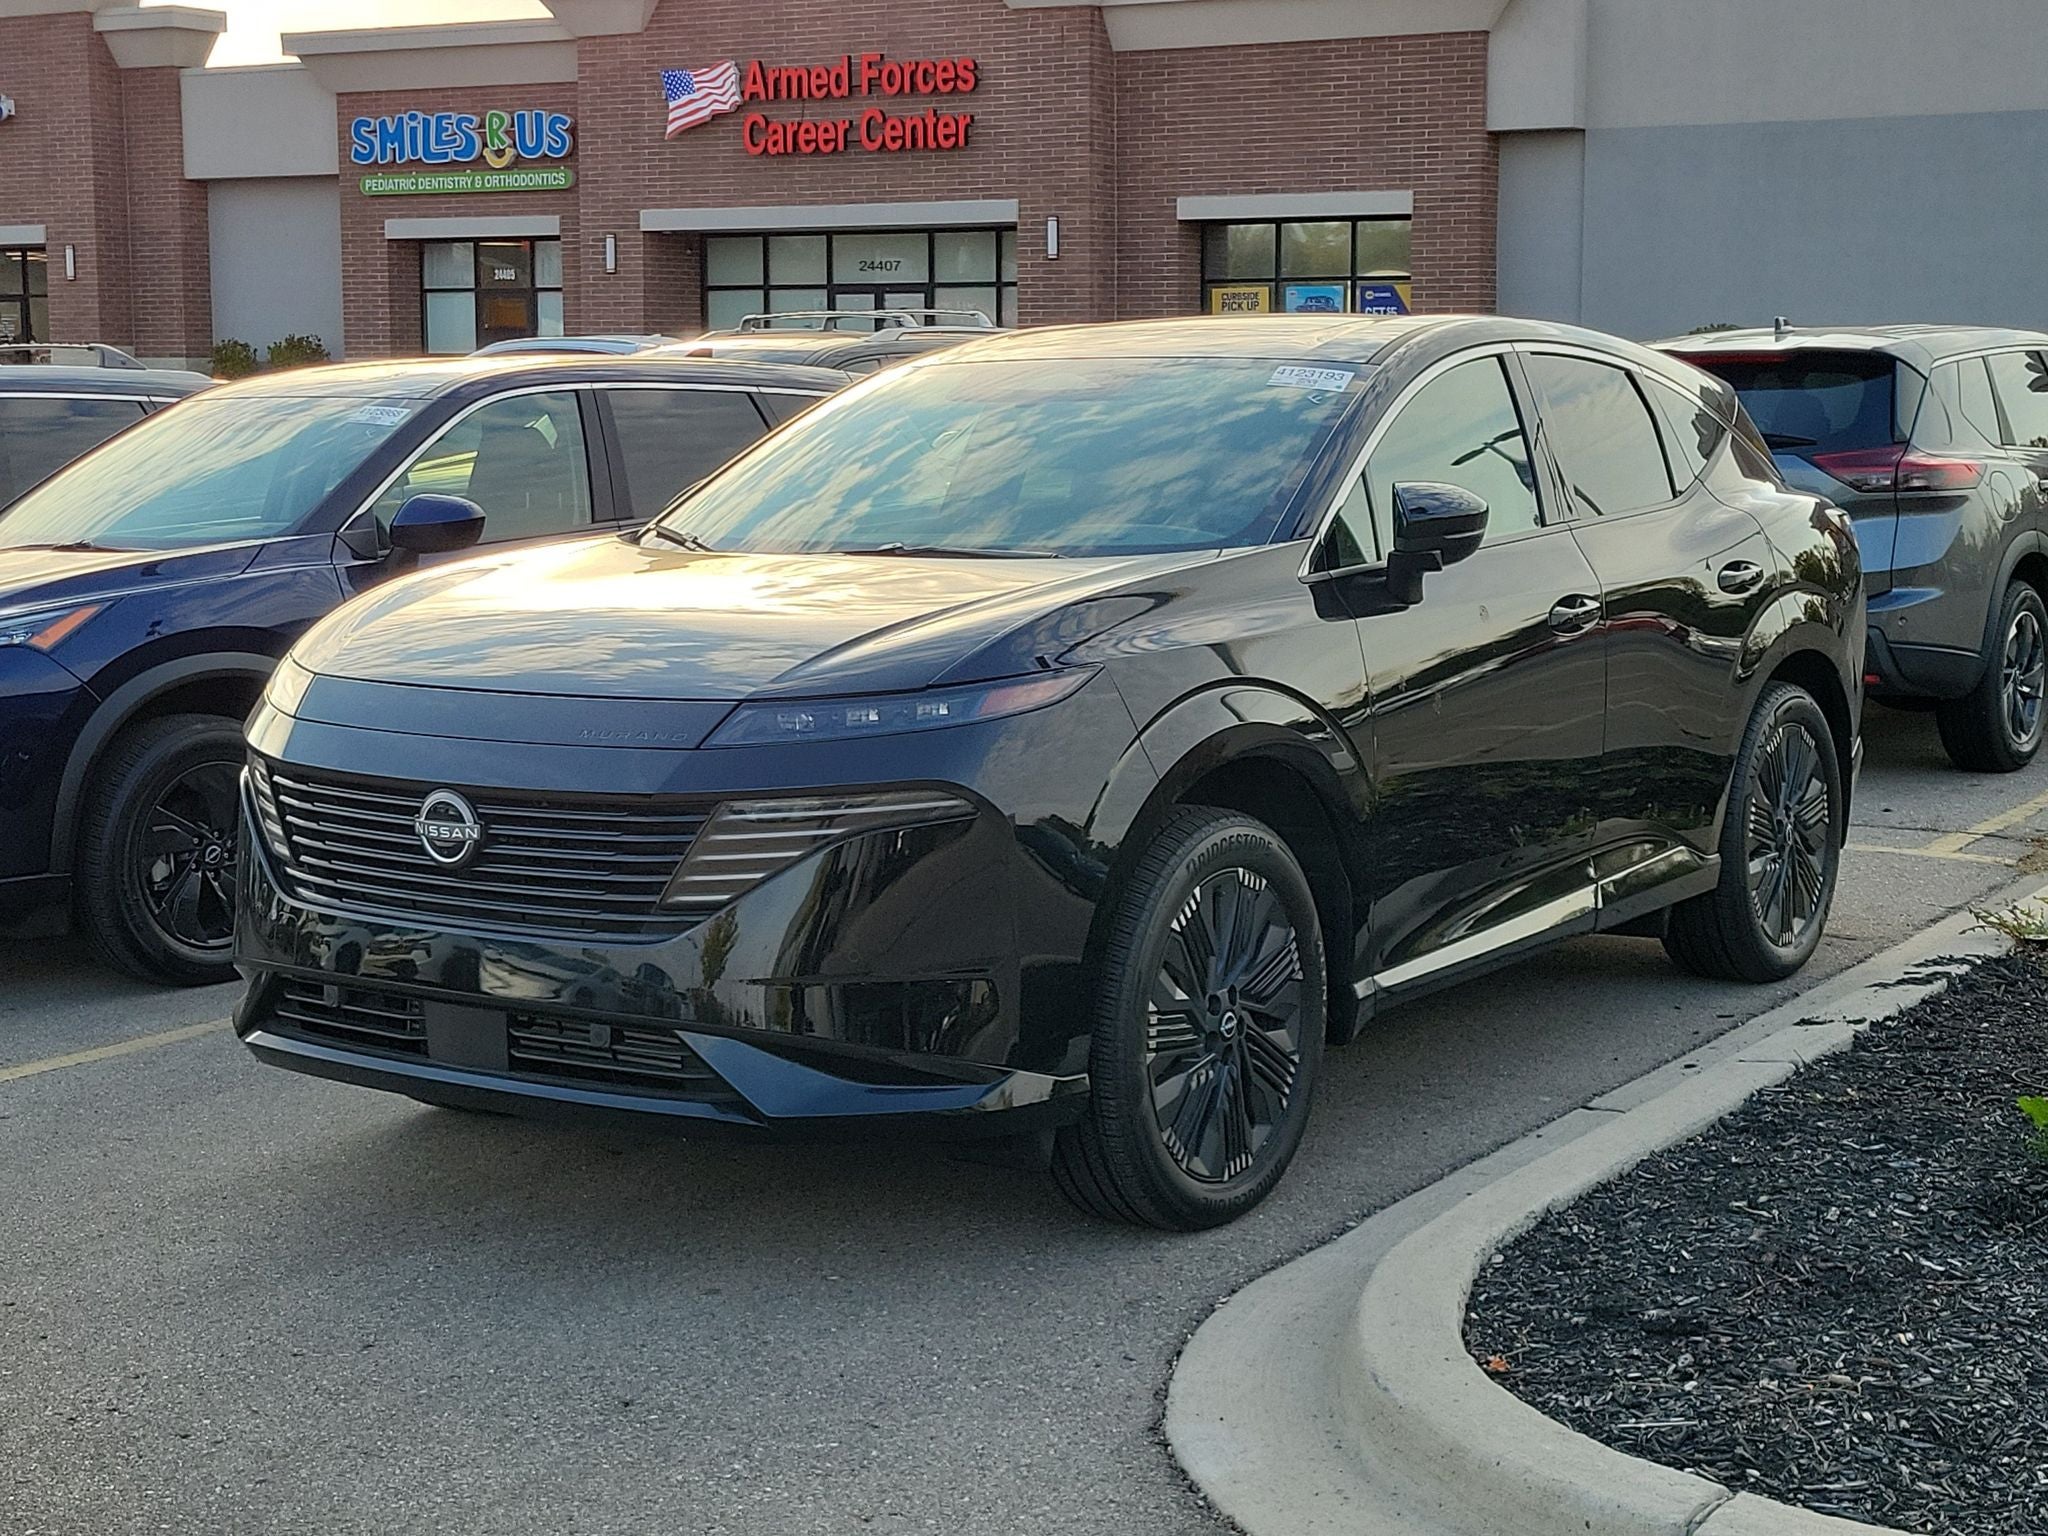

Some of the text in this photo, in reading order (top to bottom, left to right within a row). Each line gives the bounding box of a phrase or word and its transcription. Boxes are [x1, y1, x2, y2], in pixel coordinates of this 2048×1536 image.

[743, 53, 977, 101] Armed Forces
[486, 110, 508, 151] R
[514, 110, 570, 159] US
[743, 107, 972, 156] Career Center
[365, 172, 565, 191] PEDIATRIC DENTISTRY & ORTHODONTICS
[858, 260, 902, 271] 24407
[1221, 292, 1260, 301] CURBSIDE
[1221, 300, 1260, 311] PICK UP
[579, 729, 688, 741] MURANO
[415, 822, 478, 839] NISSAN
